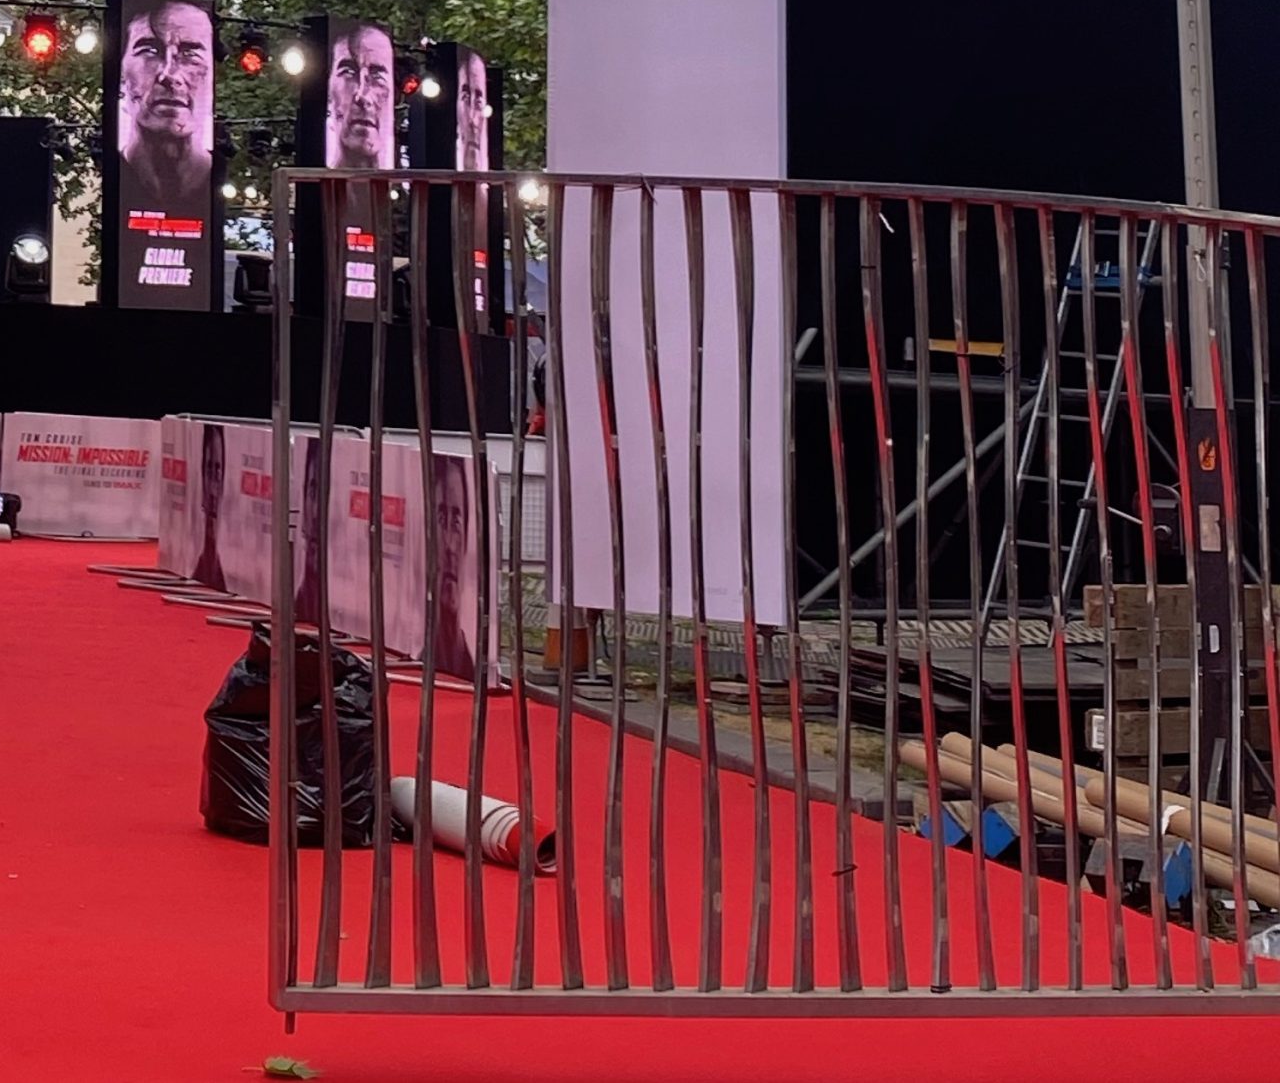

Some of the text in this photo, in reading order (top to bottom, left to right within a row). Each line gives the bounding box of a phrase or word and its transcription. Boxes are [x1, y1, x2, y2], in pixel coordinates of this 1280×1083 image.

[144, 247, 185, 266] GLOBAL
[138, 266, 193, 286] PREMIERE
[20, 432, 84, 445] TOM CRUISE
[17, 444, 73, 463] MISSION:
[76, 447, 150, 467] IMPOSSIBLE
[72, 467, 96, 477] FINAL
